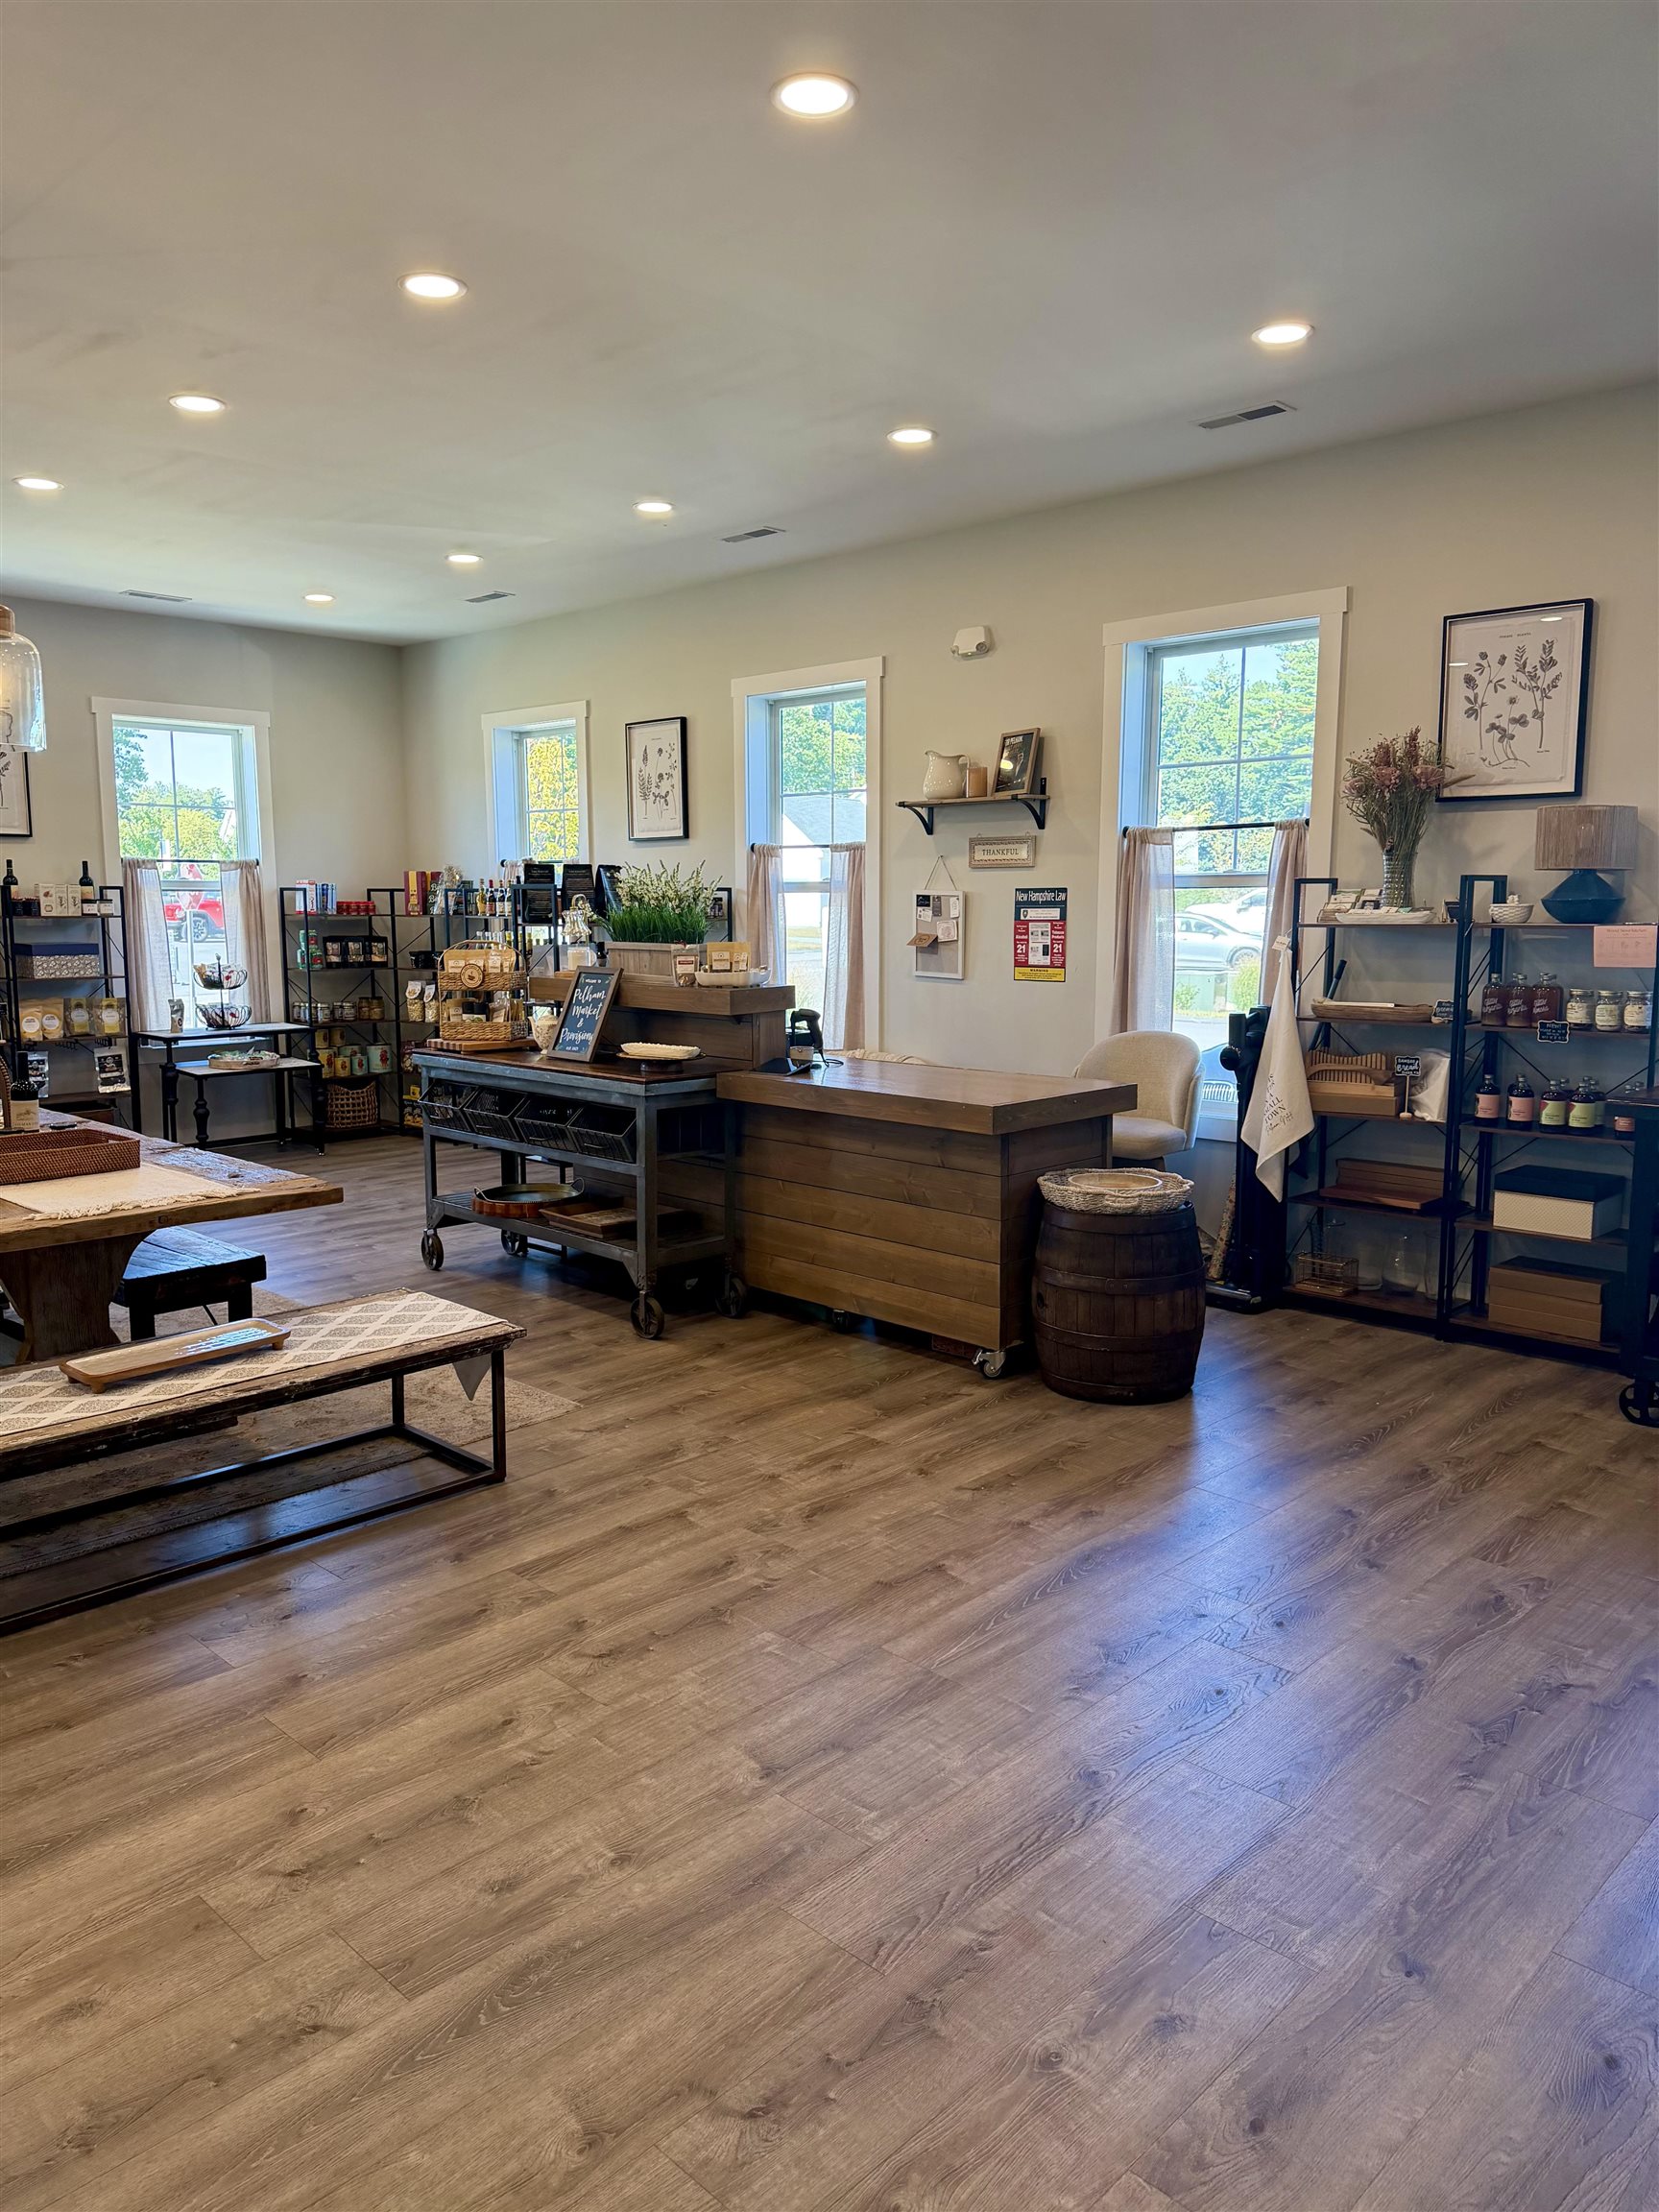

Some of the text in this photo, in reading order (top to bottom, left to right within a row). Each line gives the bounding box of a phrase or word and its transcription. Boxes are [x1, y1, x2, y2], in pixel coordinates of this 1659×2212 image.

[982, 848, 1020, 856] THANKFUL
[1016, 890, 1067, 904] New Hampshire Law
[1017, 945, 1025, 953] 21
[1053, 944, 1062, 953] 21
[572, 985, 607, 1004] Pelham
[572, 1002, 603, 1020] Market
[577, 1018, 584, 1027] &
[559, 1027, 593, 1045] Provisions
